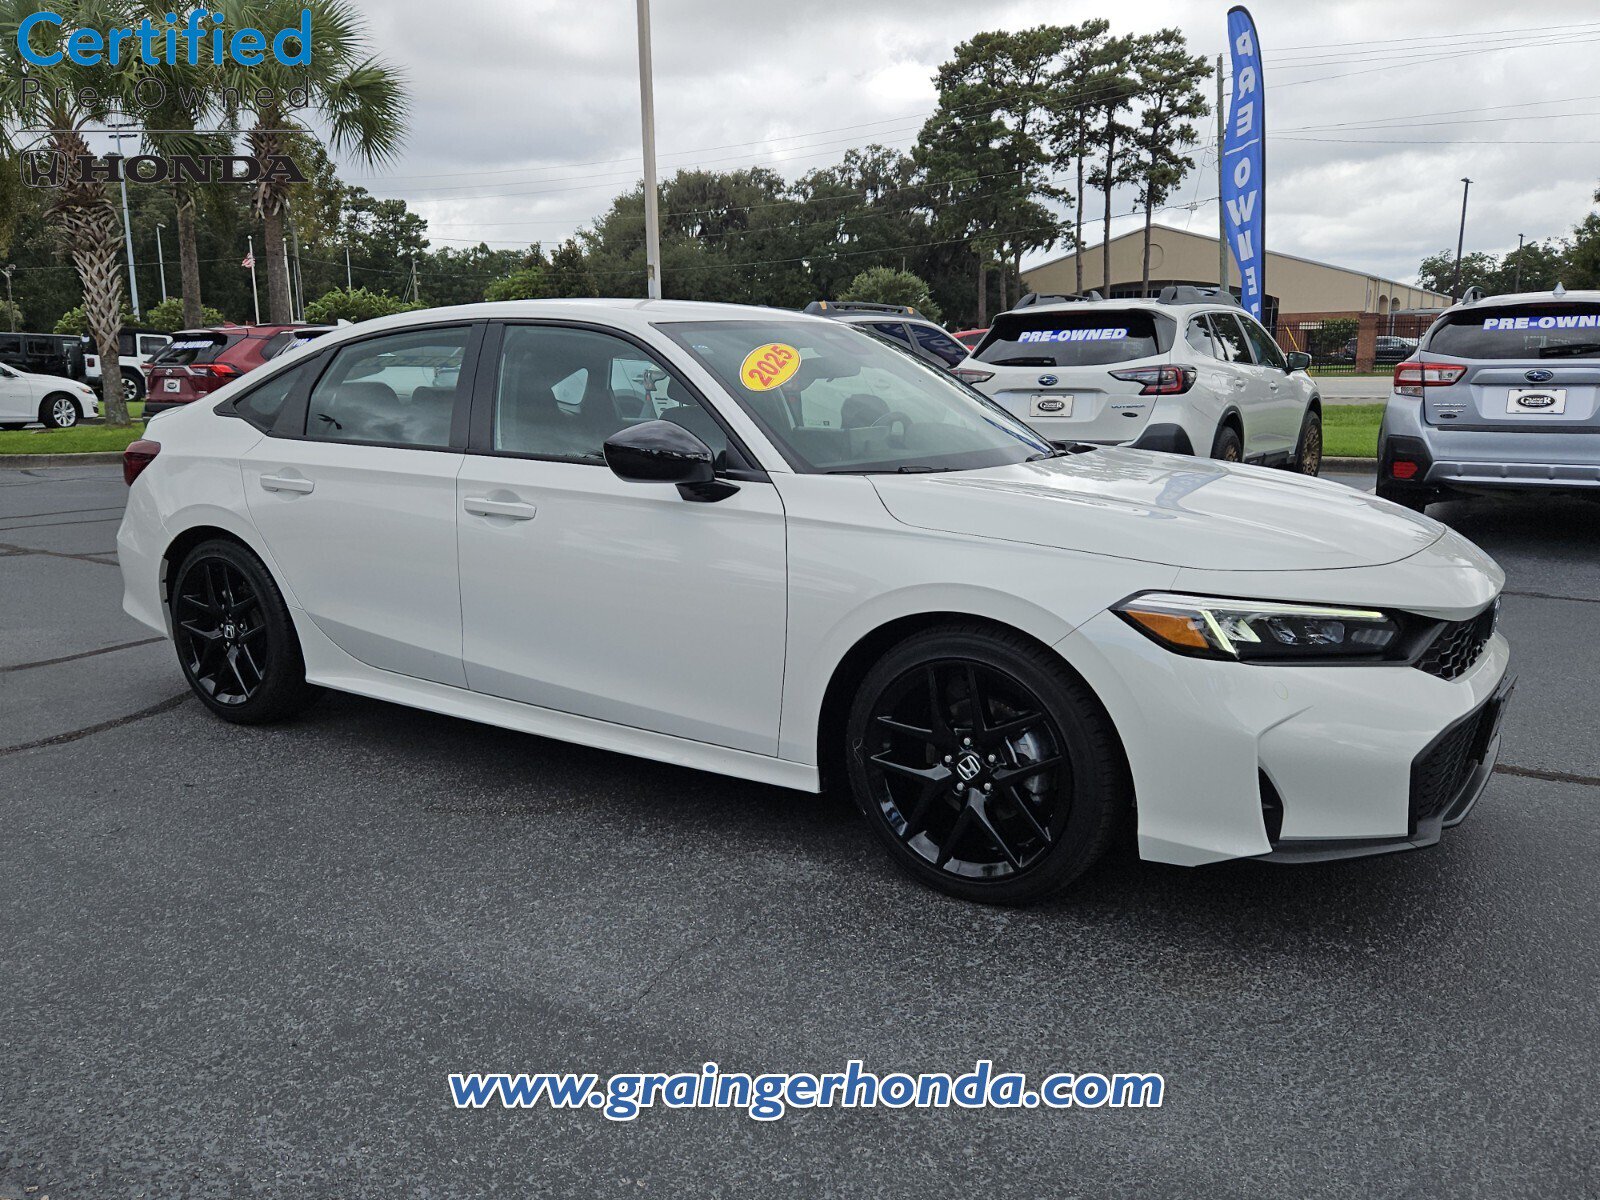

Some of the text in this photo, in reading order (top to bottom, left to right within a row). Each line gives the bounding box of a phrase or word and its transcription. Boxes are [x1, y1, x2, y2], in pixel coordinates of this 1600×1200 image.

[1483, 315, 1600, 330] PRE-OWN
[1017, 328, 1128, 343] PRE-OWNED
[748, 345, 793, 387] 2025
